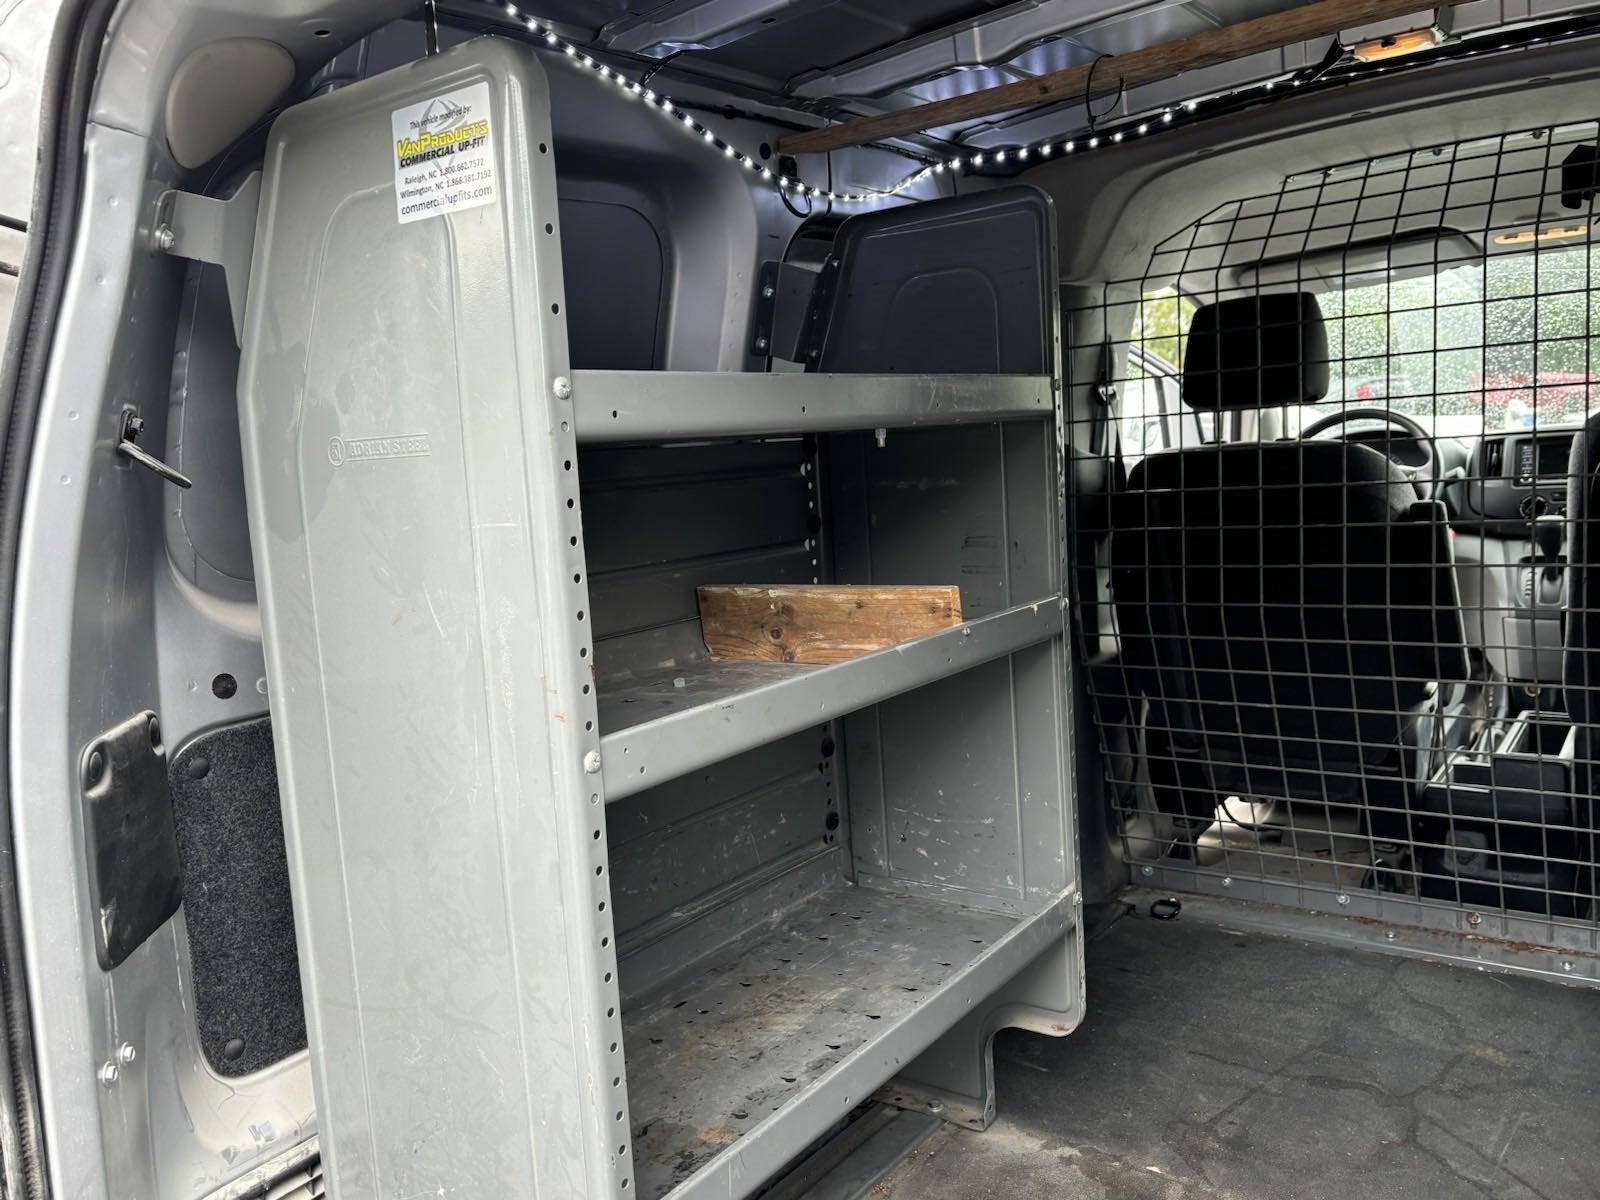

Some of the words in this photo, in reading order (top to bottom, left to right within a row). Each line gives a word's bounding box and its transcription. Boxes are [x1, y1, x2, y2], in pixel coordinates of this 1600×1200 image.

[410, 121, 420, 130] This
[420, 114, 438, 126] vehicle
[439, 108, 462, 121] modified
[461, 105, 472, 117] by:
[458, 136, 486, 152] UP-FIT
[404, 172, 428, 185] Raleigh,
[428, 170, 437, 178] NC
[400, 185, 434, 199] Wilmington,
[435, 180, 444, 190] NC
[401, 185, 493, 215] commercialupfits.com
